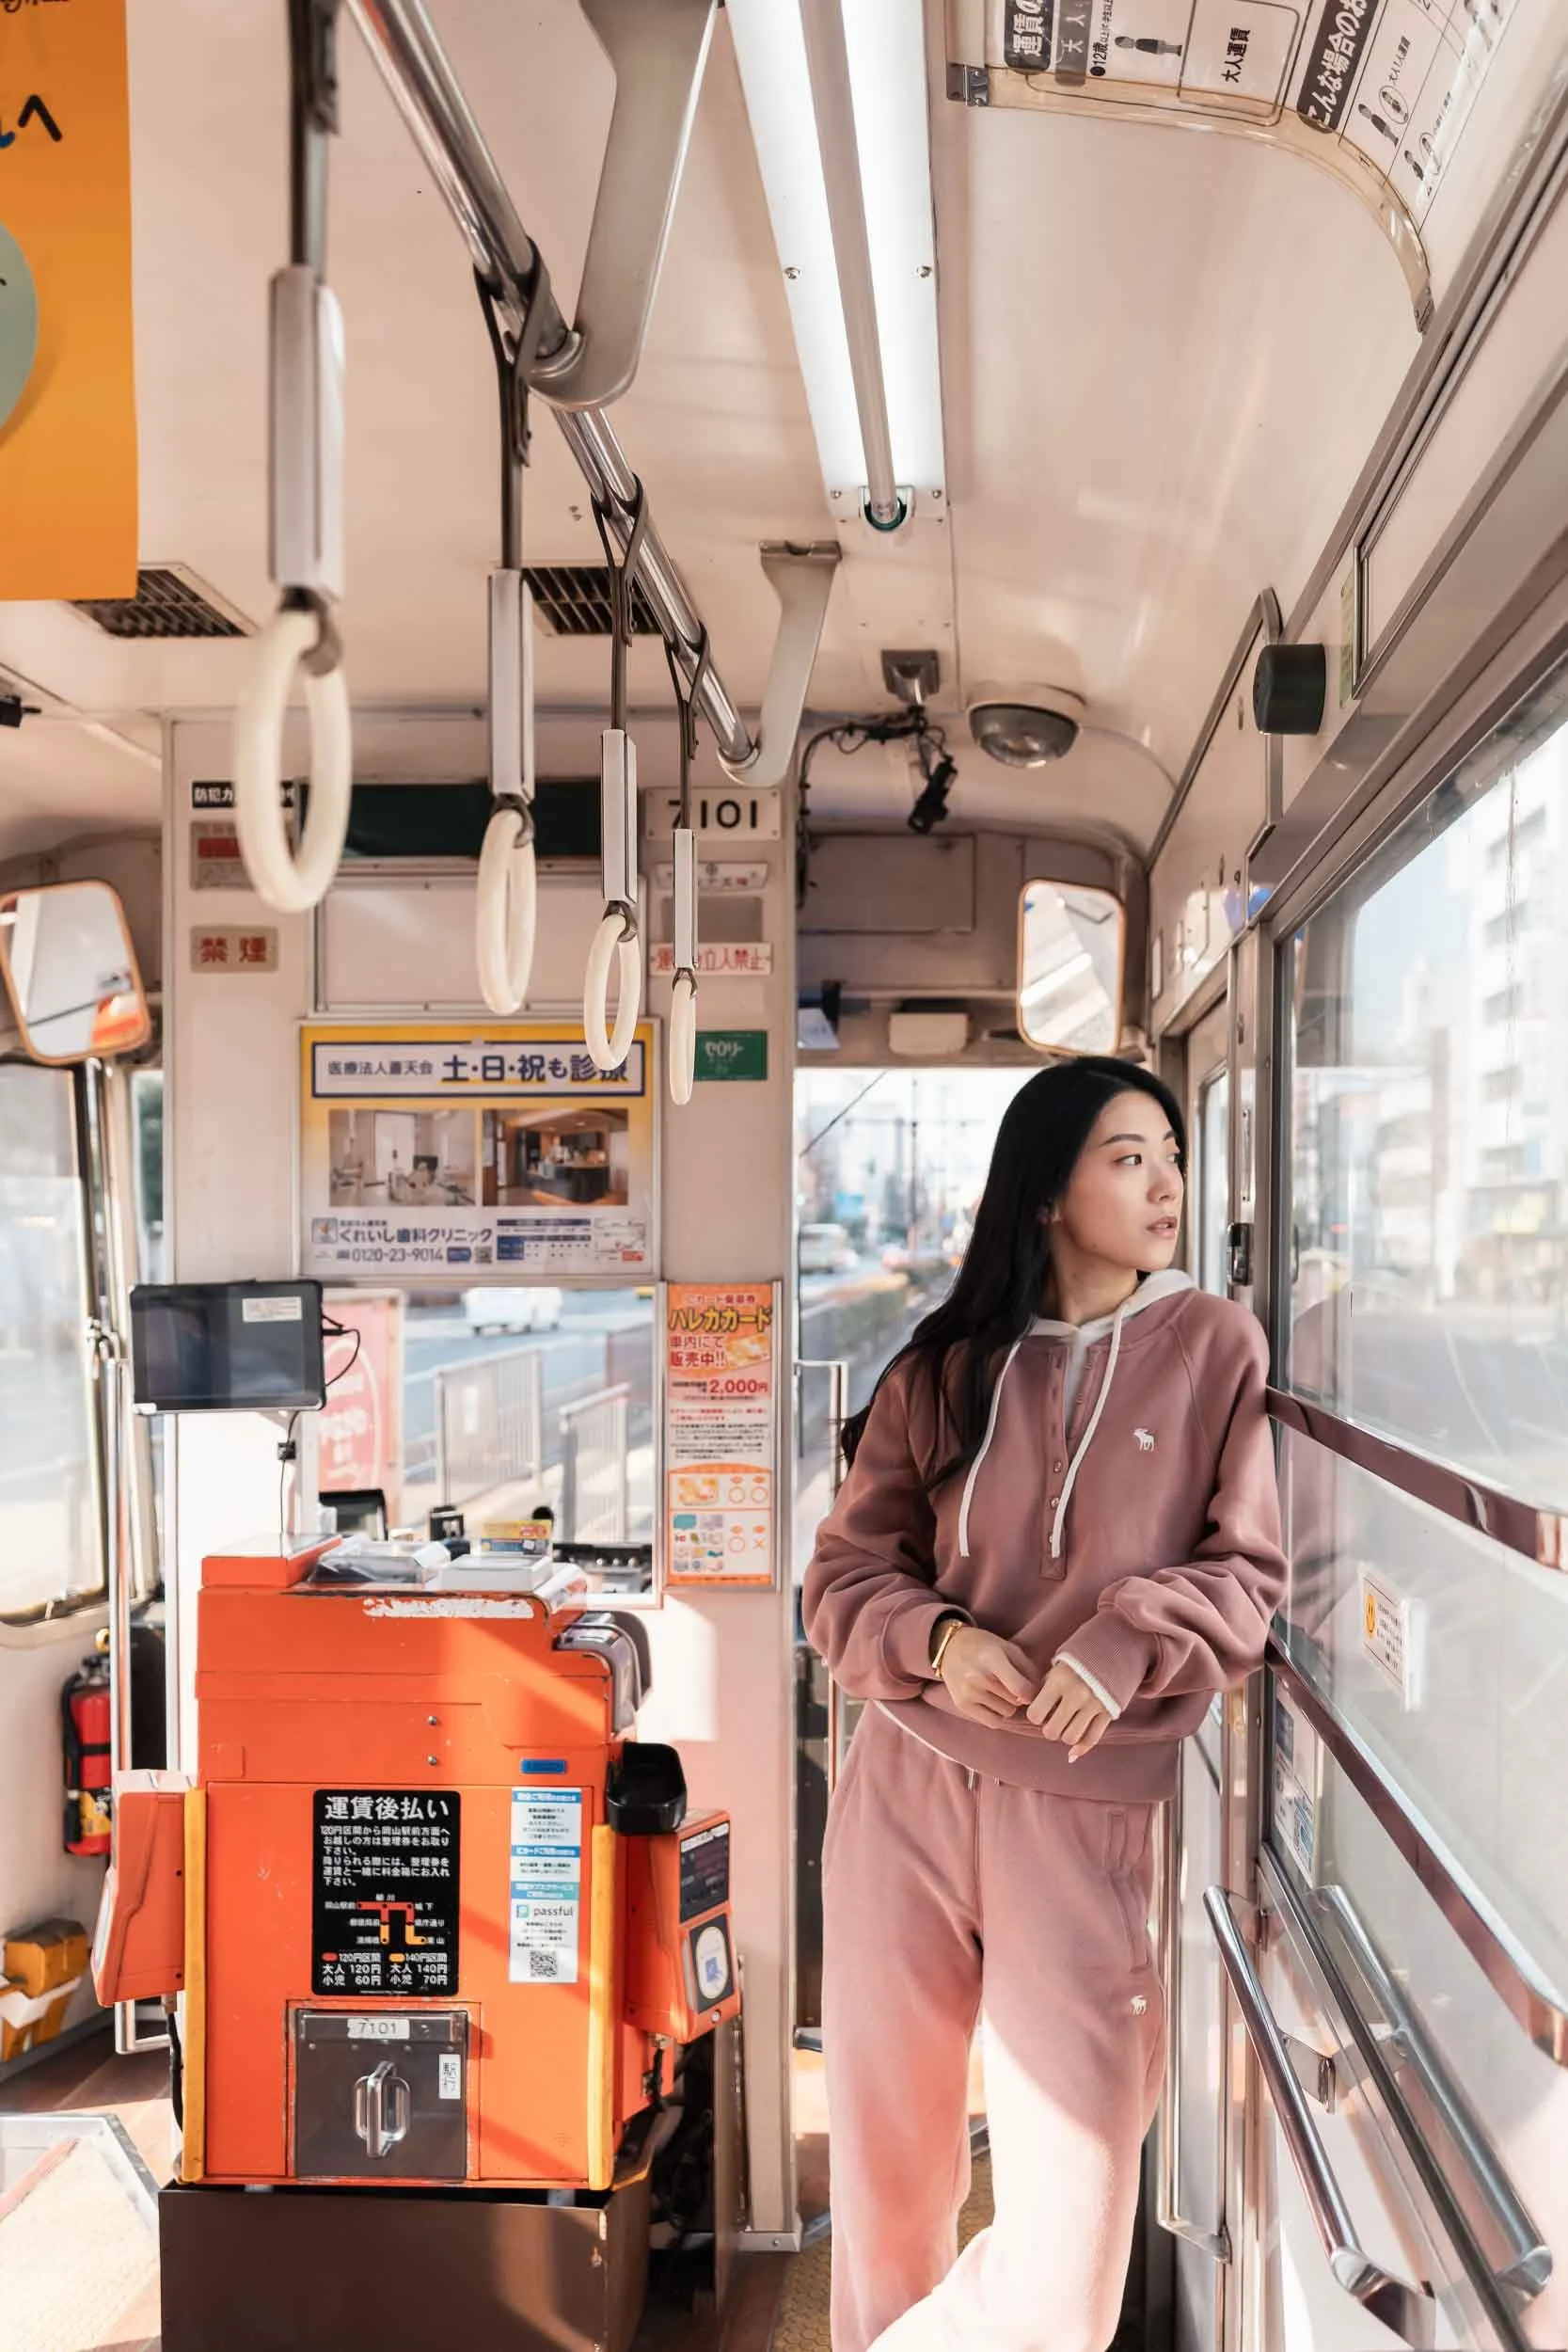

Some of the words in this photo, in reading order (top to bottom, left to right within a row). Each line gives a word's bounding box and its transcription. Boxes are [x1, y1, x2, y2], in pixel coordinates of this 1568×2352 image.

[1221, 27, 1251, 84] 大人運賃
[200, 936, 267, 963] 禁煙
[352, 1248, 444, 1262] 0120-23-9014
[668, 1306, 771, 1332] ハレカカード
[325, 1796, 450, 1820] 運賃後払い
[323, 1846, 357, 1855] 下さい。
[323, 1877, 357, 1886] 下さい。
[533, 1906, 573, 1916] passful
[322, 1964, 345, 1975] 大人
[350, 1964, 381, 1975] 120円
[390, 1963, 413, 1975] 大人
[418, 1963, 448, 1975] 140円
[355, 1976, 381, 1986] 60円
[423, 1975, 448, 1986] 70円
[359, 2022, 398, 2034] 7101
